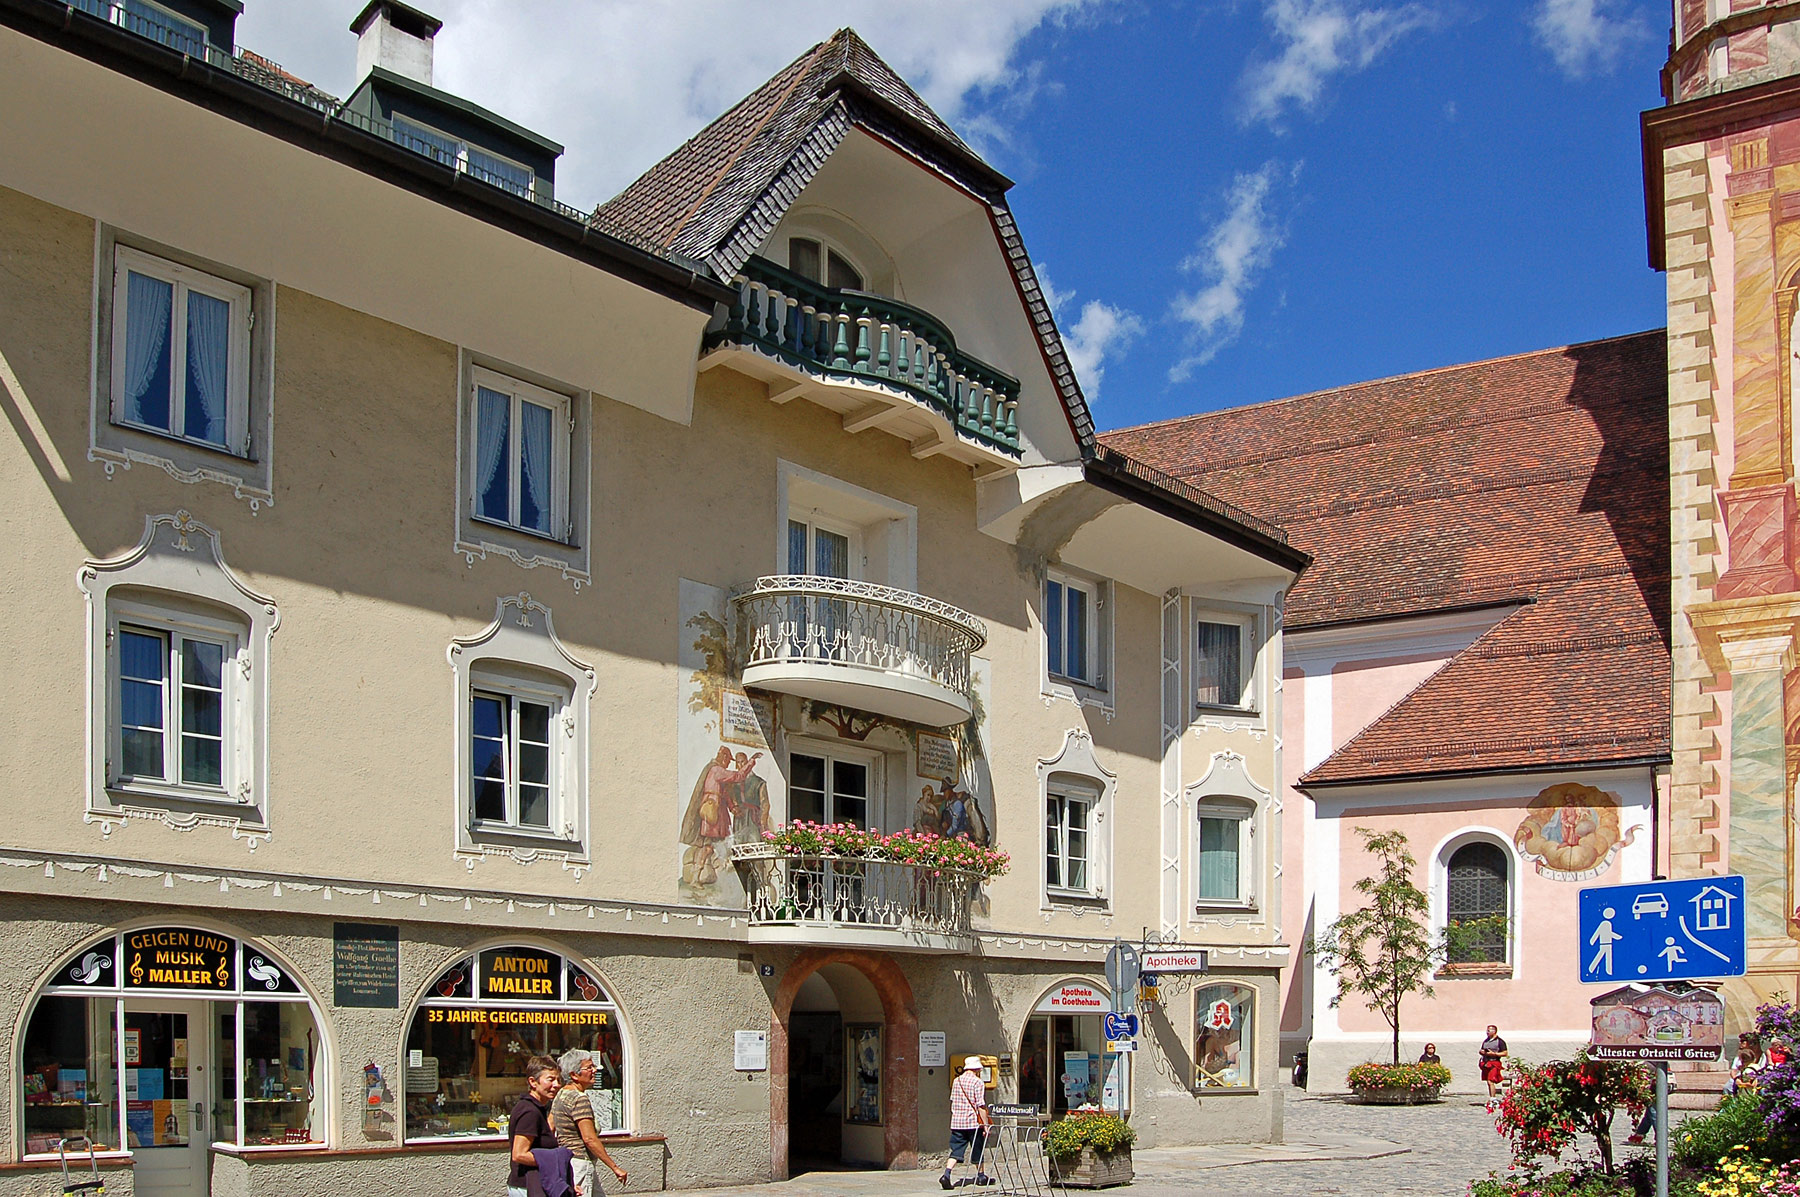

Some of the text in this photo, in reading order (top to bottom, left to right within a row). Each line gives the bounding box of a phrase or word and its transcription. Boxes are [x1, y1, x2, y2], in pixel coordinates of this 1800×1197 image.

[131, 932, 228, 953] GEIGEN UND
[156, 950, 205, 966] MUSIK
[336, 951, 369, 963] Wolfgang
[1146, 955, 1198, 969] Apotheke
[492, 956, 549, 974] ANTON
[764, 965, 771, 976] 2
[148, 968, 213, 985] MALLER
[488, 977, 553, 995] MALLER
[1061, 987, 1092, 997] Apotheke
[1061, 997, 1101, 1006] Goethehaus
[428, 1009, 608, 1025] 35 JAHRE GEIGENBAUMEISTER
[1595, 1045, 1717, 1059] Ältester Ortsteil Gries
